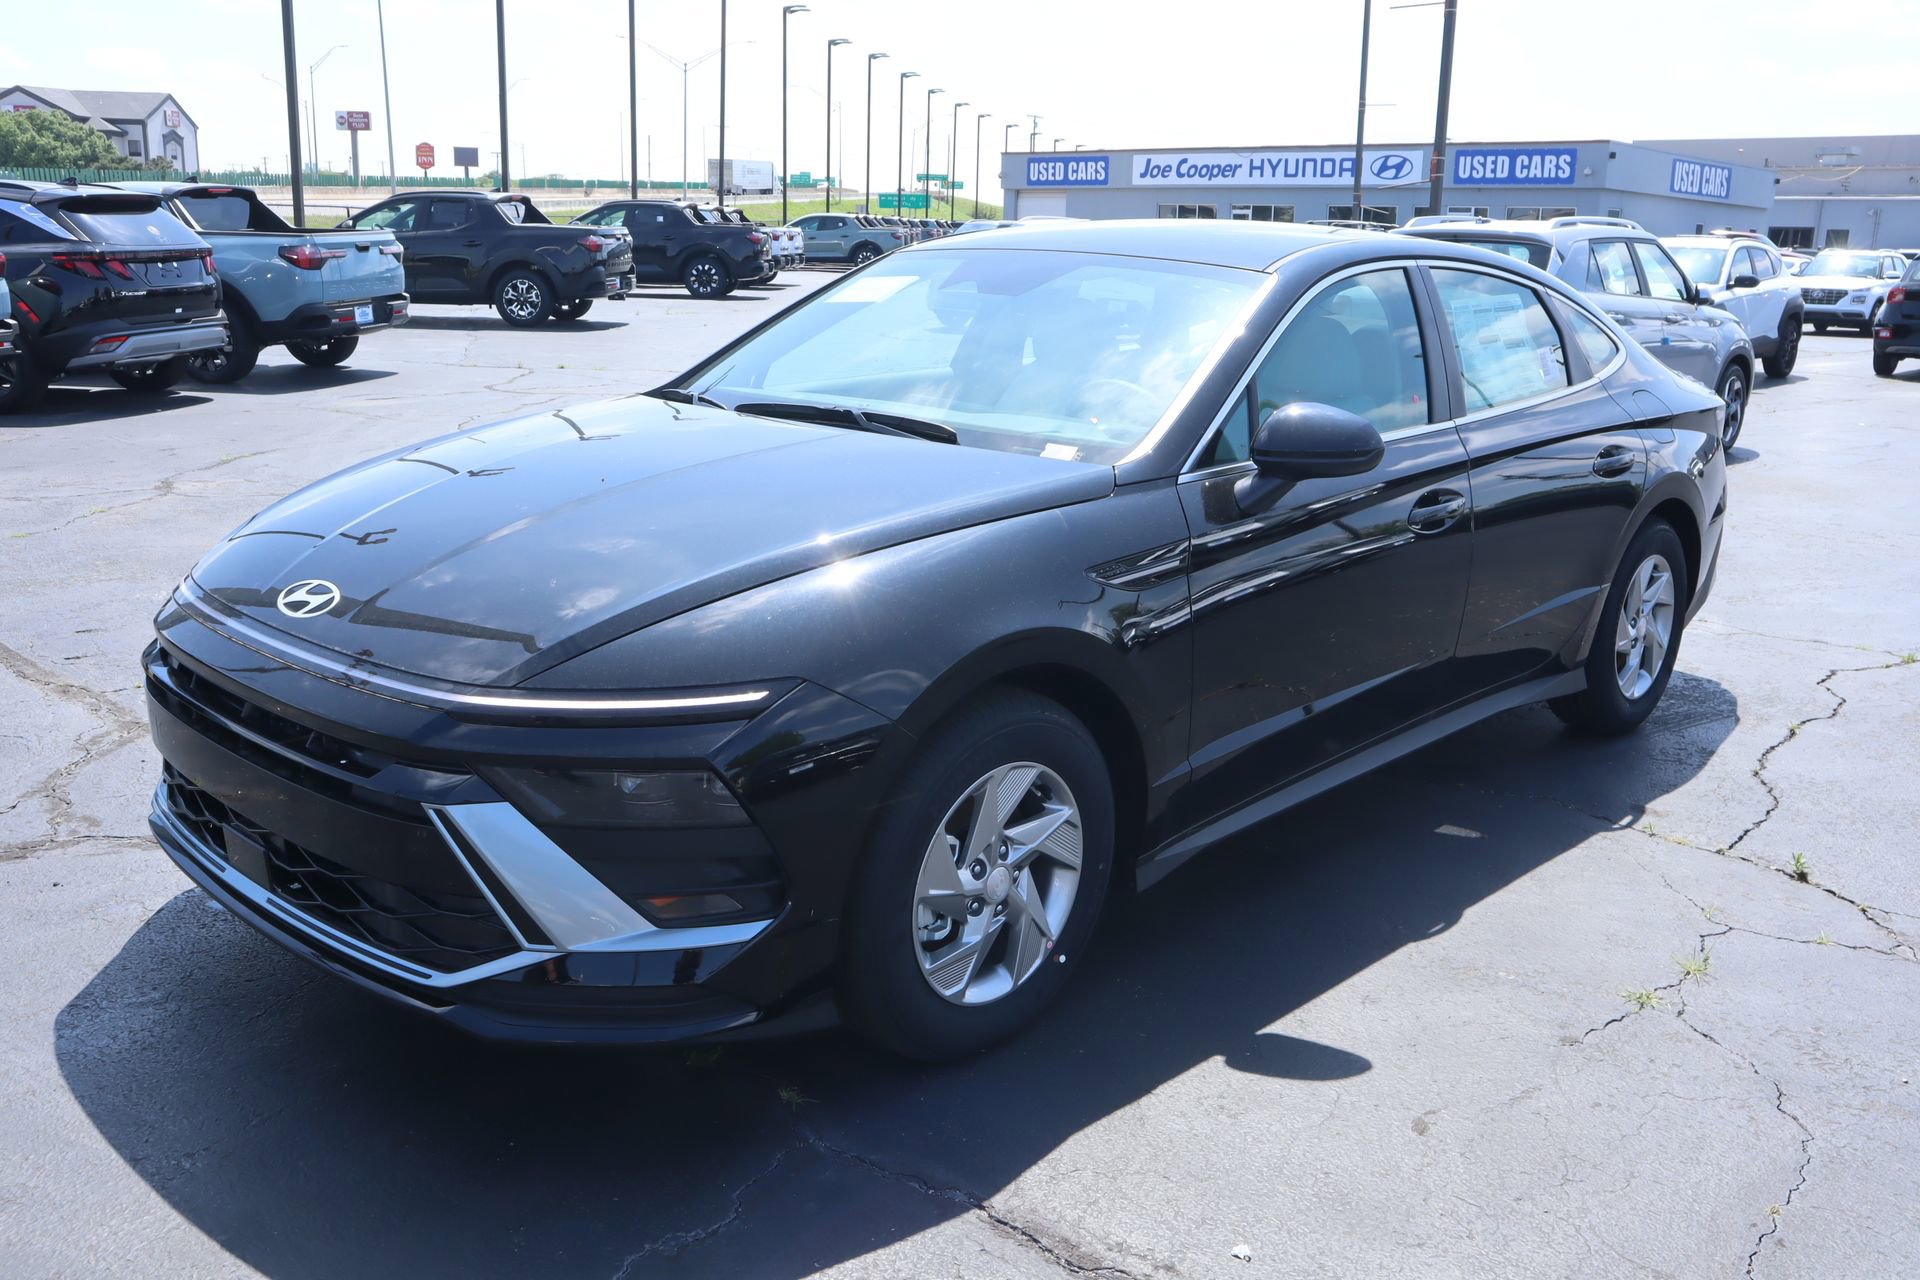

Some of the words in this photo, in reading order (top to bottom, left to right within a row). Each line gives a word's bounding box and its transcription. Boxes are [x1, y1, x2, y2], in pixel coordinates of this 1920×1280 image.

[418, 154, 433, 163] INN
[1030, 162, 1064, 181] USED
[1068, 160, 1106, 180] CARS
[1140, 158, 1171, 179] Joe
[1176, 158, 1242, 181] Cooper
[1249, 157, 1356, 179] HYUNDA
[1459, 156, 1509, 179] USED
[1515, 154, 1571, 178] CARS
[1674, 161, 1702, 193] USED
[1702, 166, 1728, 198] CARS
